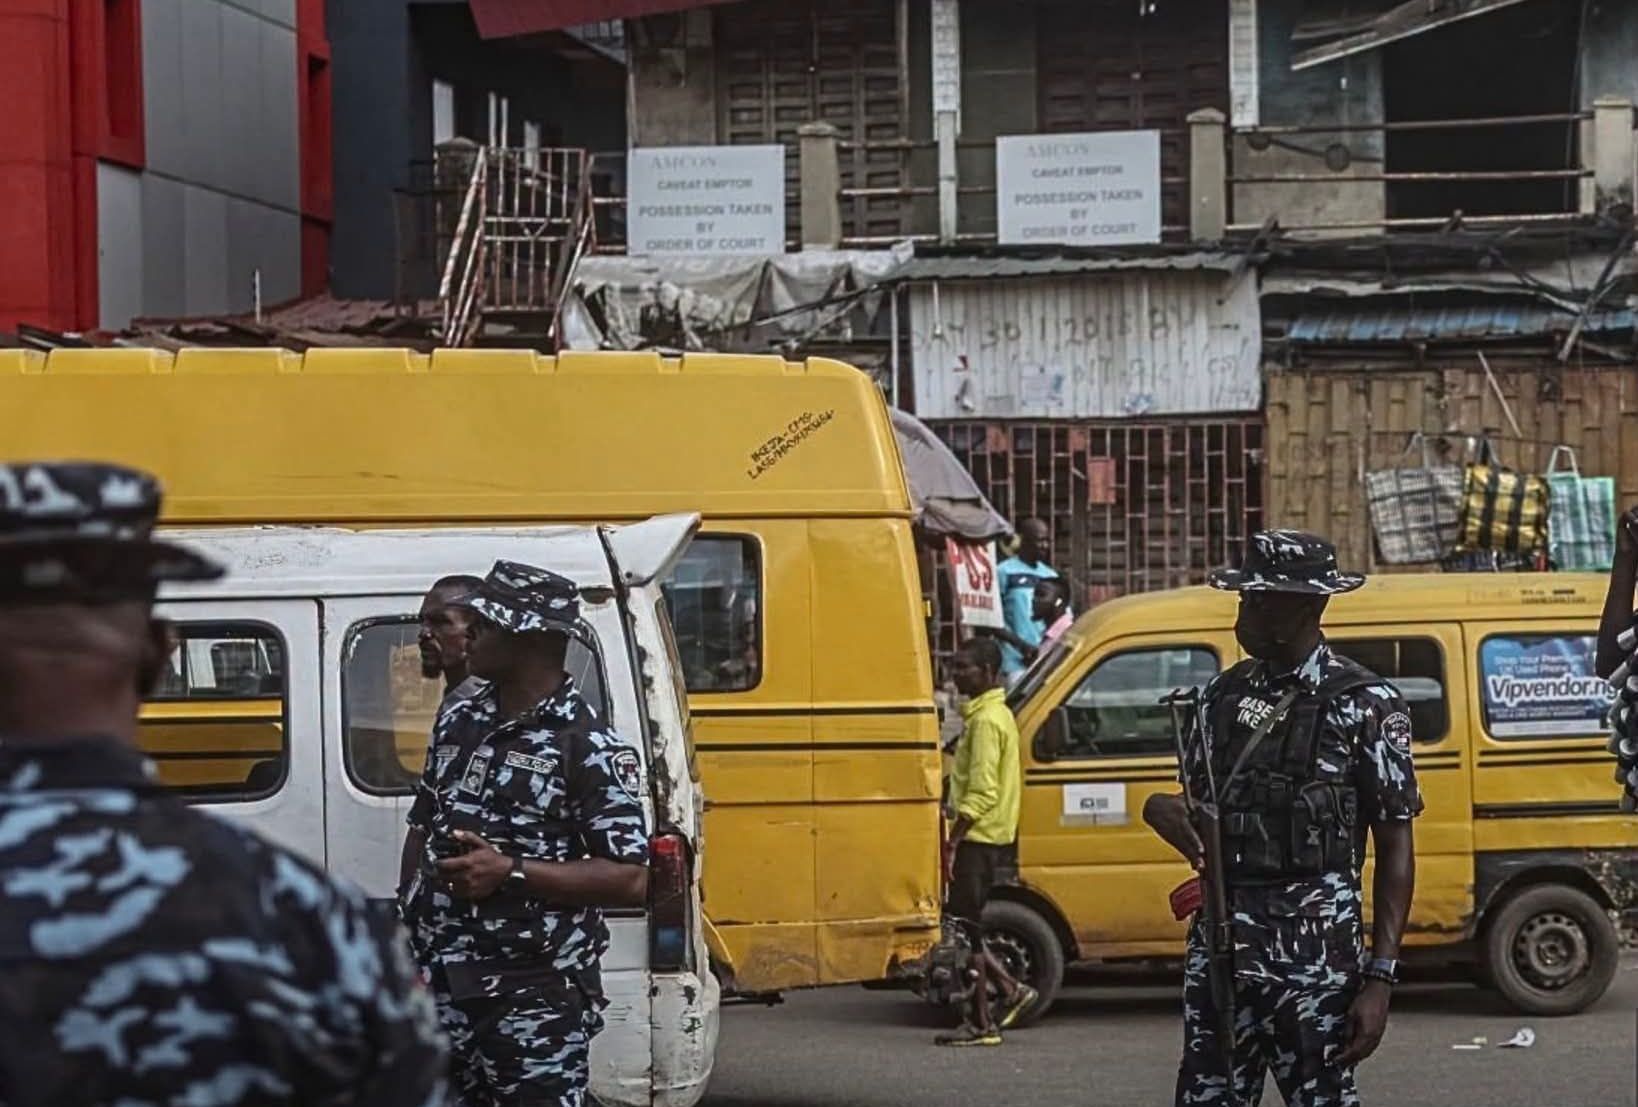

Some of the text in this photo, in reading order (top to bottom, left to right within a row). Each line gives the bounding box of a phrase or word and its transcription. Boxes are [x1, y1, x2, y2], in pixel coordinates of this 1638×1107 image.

[1032, 165, 1123, 179] CAVEAT EMPTOR
[657, 178, 753, 191] CAVEAT EMPTOR
[1014, 189, 1143, 206] POSSESSION TAKEN
[638, 203, 773, 217] POSSESSION TAKEN
[1069, 208, 1088, 220] BY
[696, 222, 715, 233] BY
[1022, 223, 1136, 239] ORDER OF COURT
[646, 237, 766, 250] ORDER OF COURT
[1238, 696, 1274, 719] BASE
